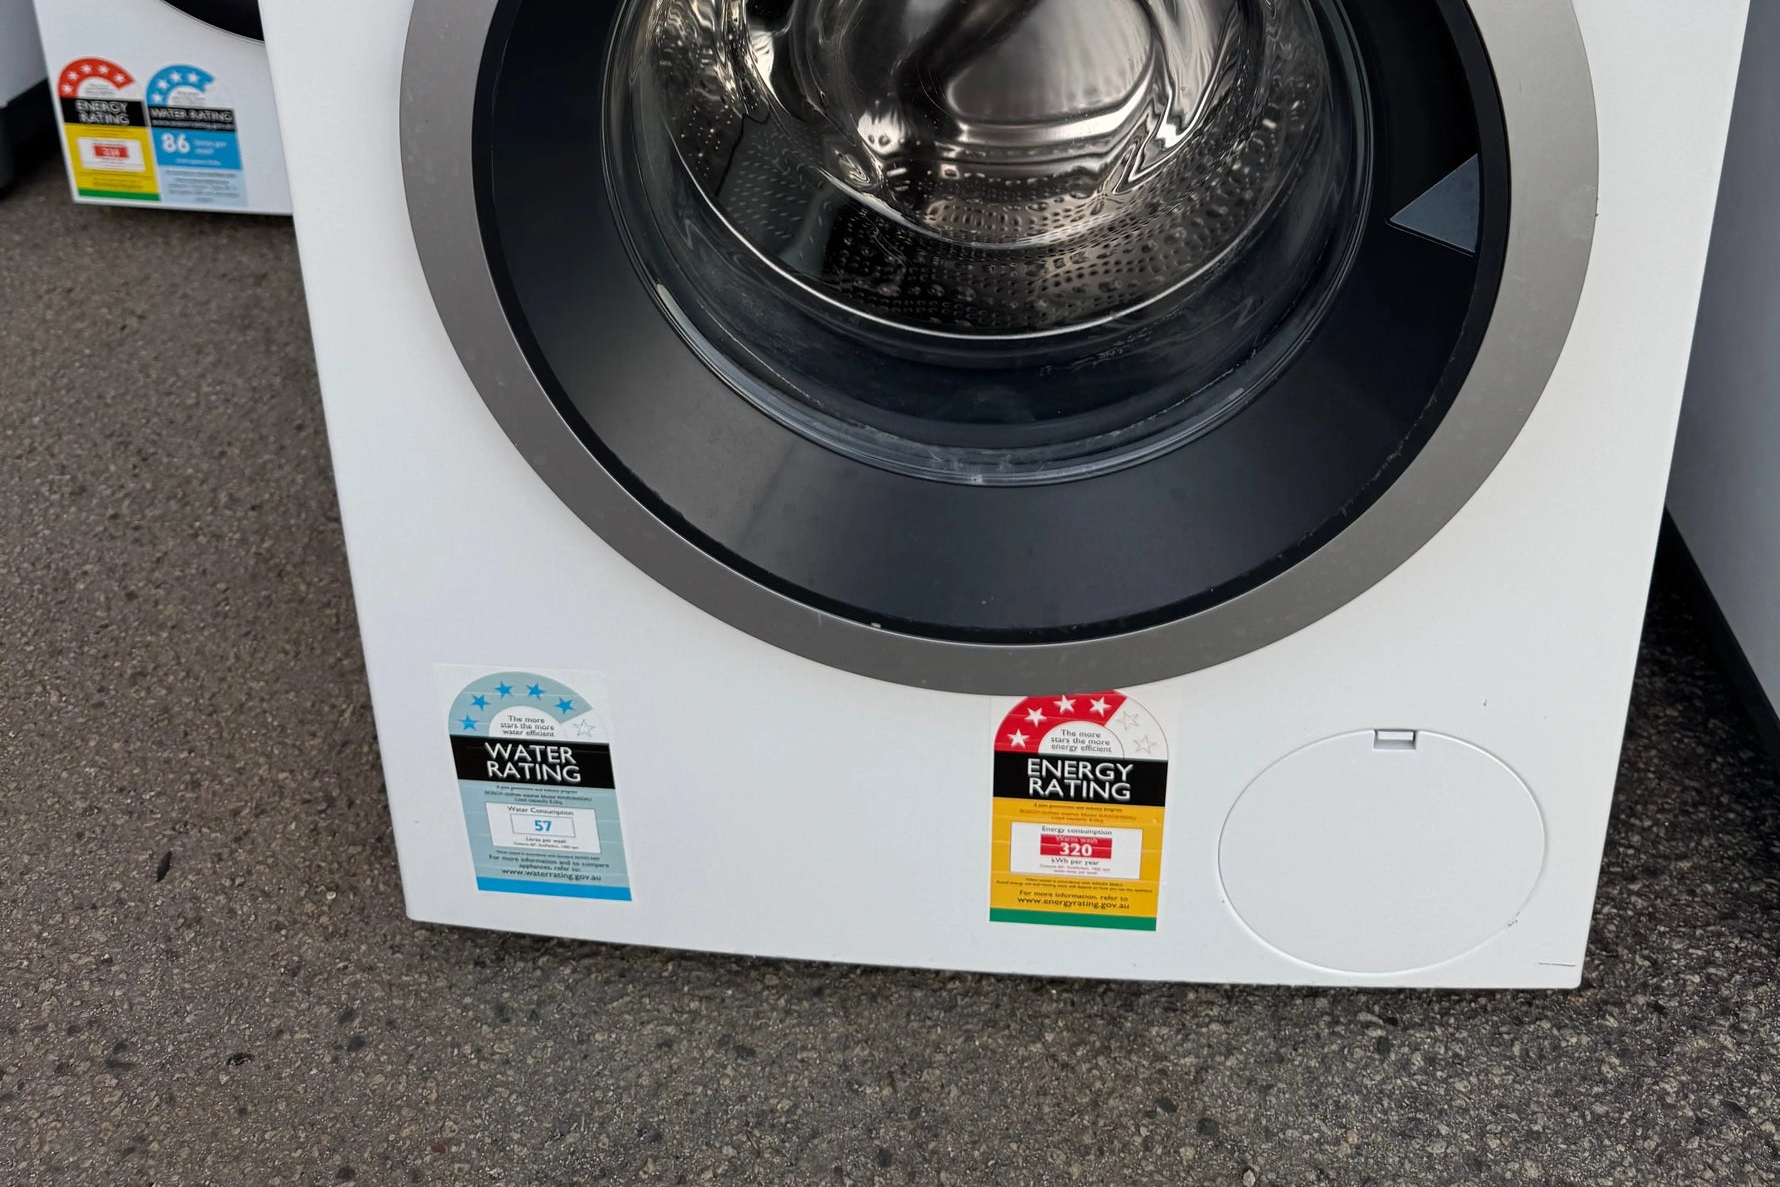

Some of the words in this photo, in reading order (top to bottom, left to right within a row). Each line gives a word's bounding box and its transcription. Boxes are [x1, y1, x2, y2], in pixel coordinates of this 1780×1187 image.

[76, 100, 128, 113] ENERGY
[79, 112, 129, 125] RATING
[150, 108, 187, 118] WATER
[189, 110, 233, 122] RATING
[161, 133, 190, 154] 86
[485, 742, 576, 764] WATER
[1051, 744, 1078, 752] energy
[1081, 745, 1112, 753] efficient
[487, 761, 581, 783] RATING
[1027, 758, 1134, 781] ENERGY
[1028, 778, 1131, 800] RATING
[534, 820, 552, 832] 57
[1067, 827, 1112, 835] consumption
[1060, 843, 1093, 856] 320
[502, 869, 601, 881] www.waterrating.gov.au
[1017, 897, 1130, 910] www.energyrating.gov.au
